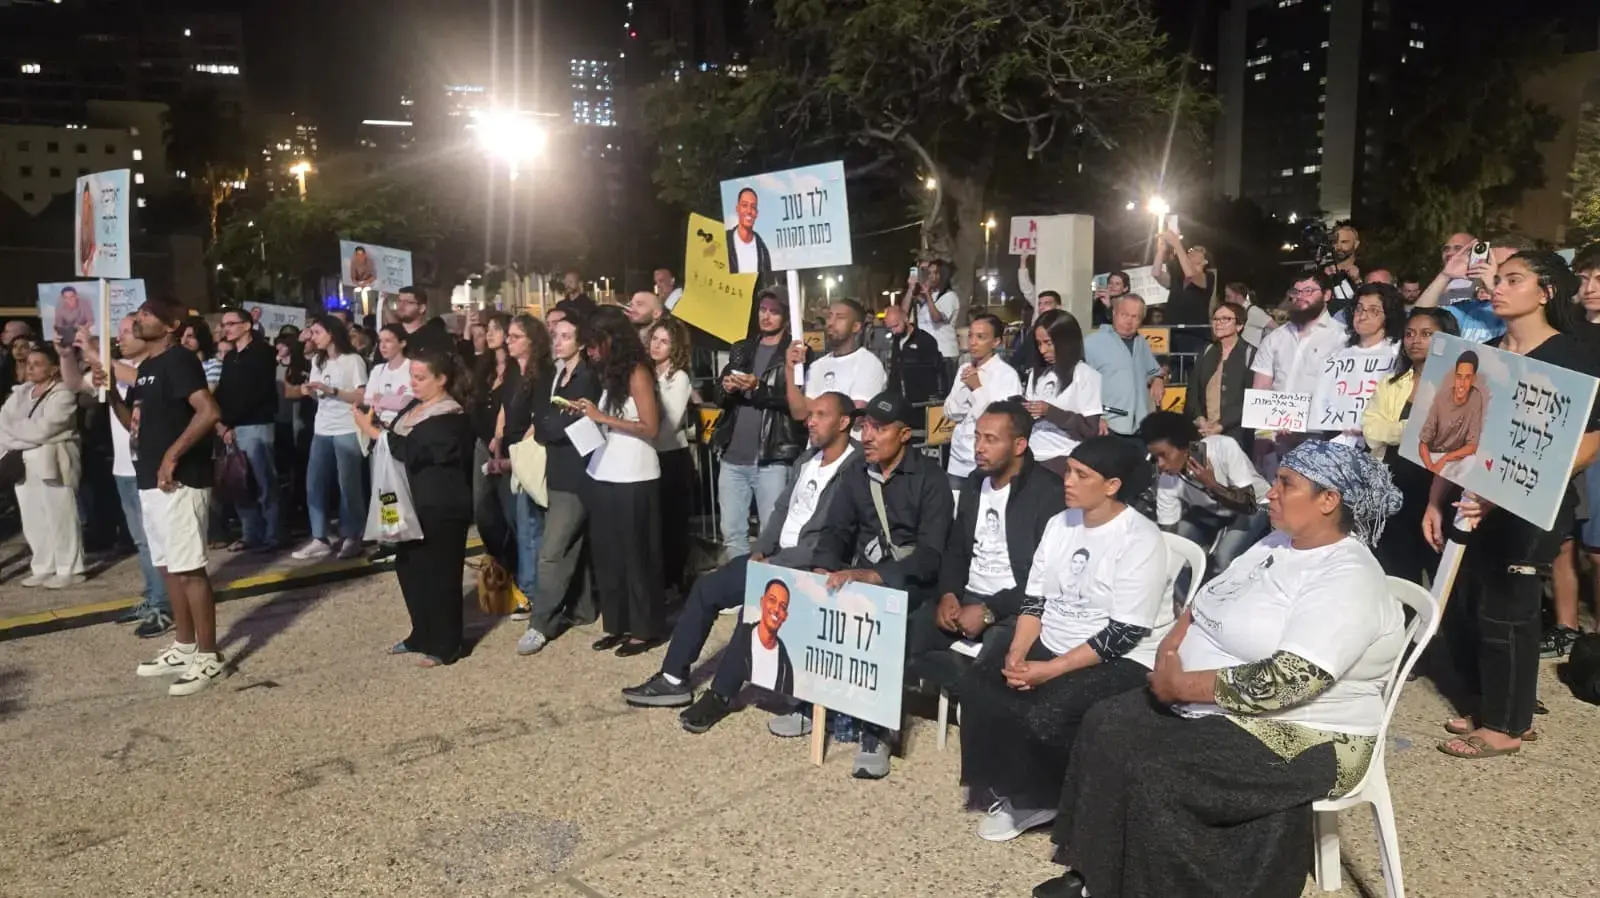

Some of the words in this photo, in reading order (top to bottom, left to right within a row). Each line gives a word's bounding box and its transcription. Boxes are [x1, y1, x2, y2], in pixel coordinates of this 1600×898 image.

[780, 193, 803, 221] טוב
[807, 187, 828, 217] ילד
[776, 226, 806, 249] תקווה
[810, 222, 832, 245] פתח
[1324, 357, 1355, 378] מקל
[817, 607, 846, 644] טוב
[853, 612, 881, 651] ילד
[805, 645, 843, 680] תקווה
[849, 657, 878, 691] פתח
